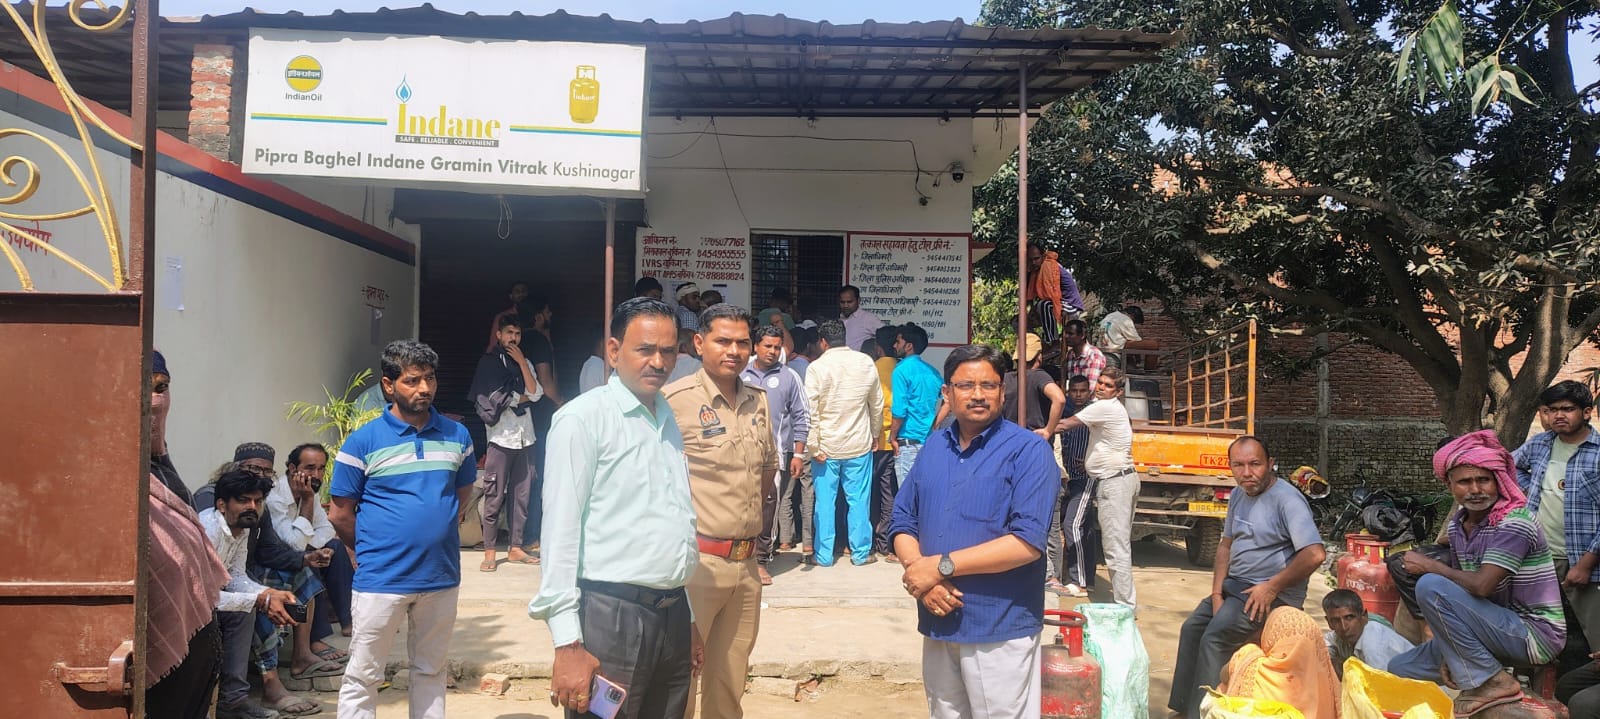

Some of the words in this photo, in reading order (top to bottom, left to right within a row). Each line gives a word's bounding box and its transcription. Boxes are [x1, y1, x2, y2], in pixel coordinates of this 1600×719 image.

[285, 92, 322, 101] IndianOil
[397, 103, 501, 138] Indane
[420, 137, 448, 145] RELIABLE
[453, 139, 495, 147] CONVENIENT
[255, 148, 298, 166] Pipra
[304, 150, 361, 169] Baghel
[367, 153, 425, 170] Indane
[431, 156, 493, 173] Gramin
[498, 159, 548, 175] Vitrak
[553, 161, 636, 182] Kushinagar
[641, 258, 663, 268] IVRS
